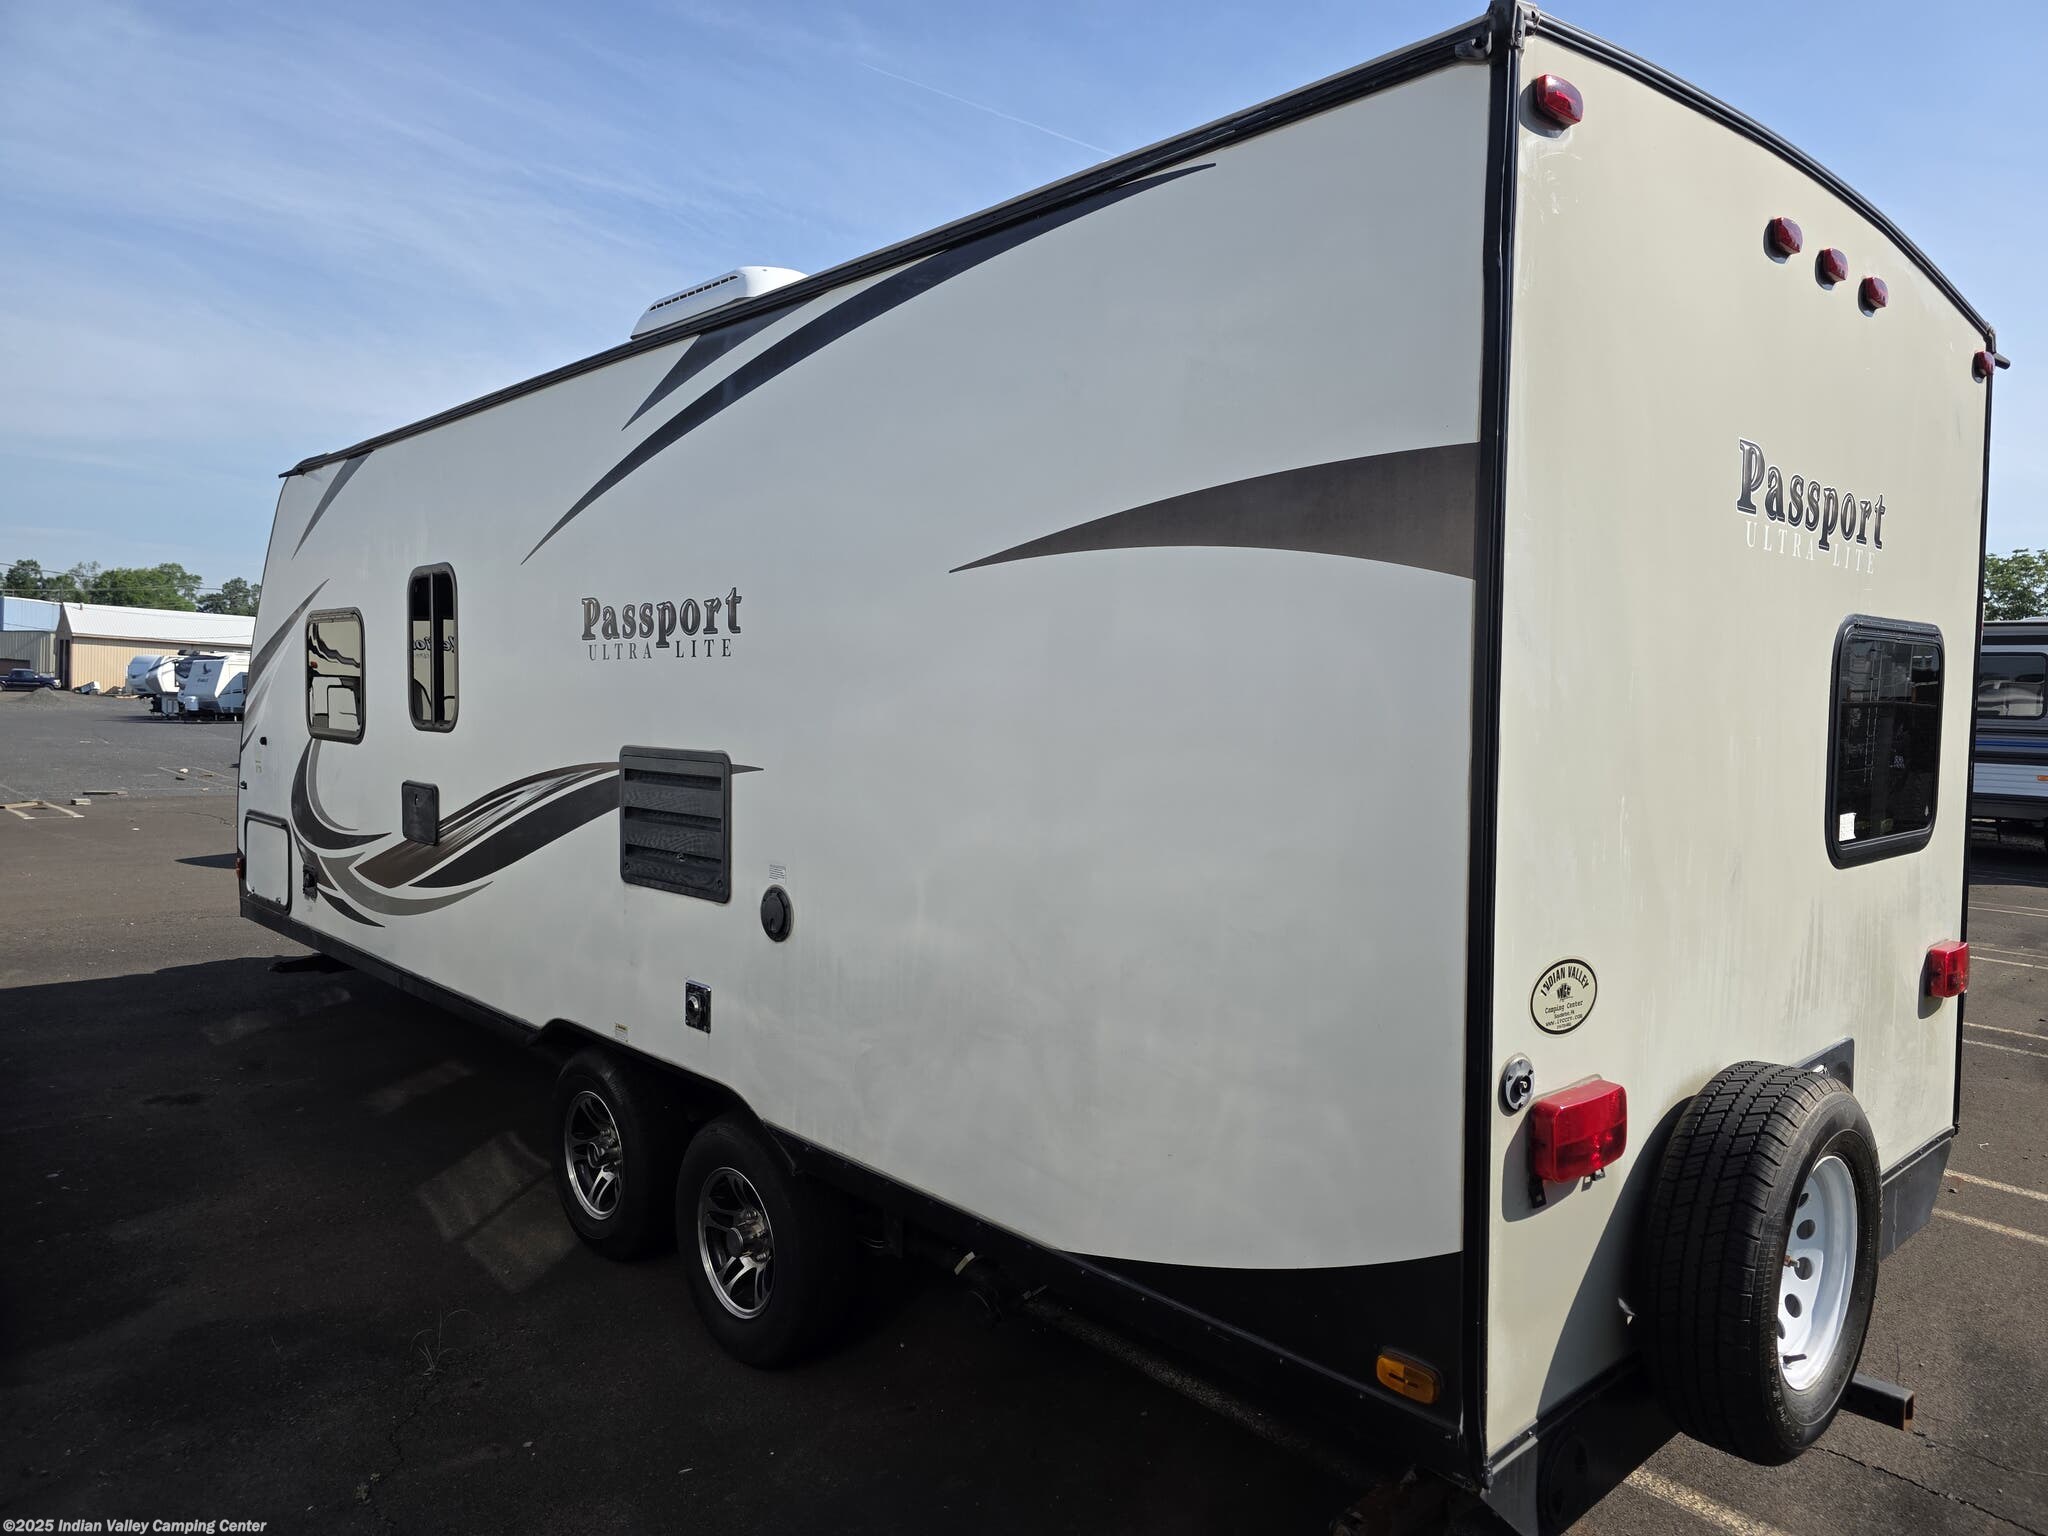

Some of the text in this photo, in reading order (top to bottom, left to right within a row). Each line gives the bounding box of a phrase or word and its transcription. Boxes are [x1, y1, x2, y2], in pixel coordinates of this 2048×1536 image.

[1736, 437, 1886, 552] Passport
[1746, 521, 1875, 574] ULTRA LITE
[581, 587, 743, 649] Passport
[588, 638, 732, 661] ULTRA LITE
[1540, 967, 1566, 997] INDIAN
[1567, 965, 1590, 990] VALLEY
[1544, 1000, 1584, 1014] Camping Center
